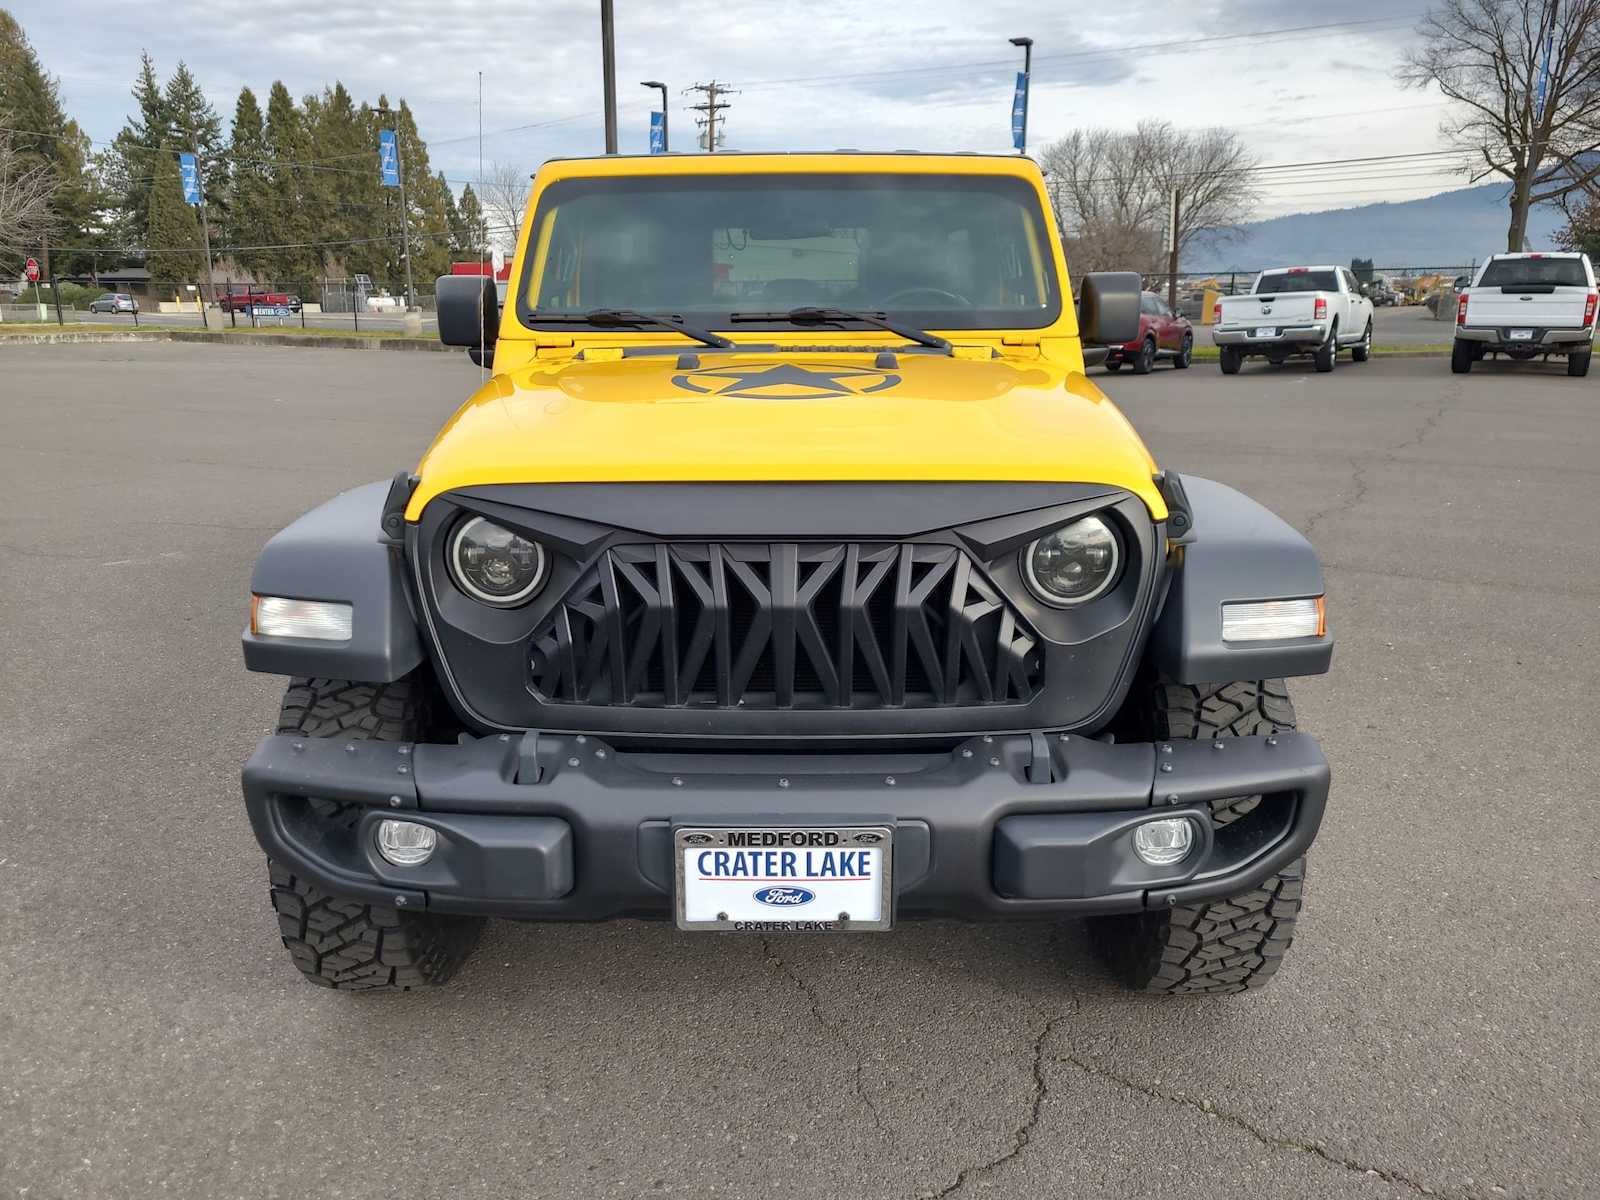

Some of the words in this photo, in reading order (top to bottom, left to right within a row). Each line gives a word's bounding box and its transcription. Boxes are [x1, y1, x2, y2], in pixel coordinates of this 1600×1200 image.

[728, 832, 839, 846] MEDFORD
[697, 851, 797, 877] CRATER
[806, 851, 871, 877] LAKE
[765, 888, 803, 904] Ford
[734, 921, 790, 931] CRATER
[795, 921, 832, 931] LAKE
